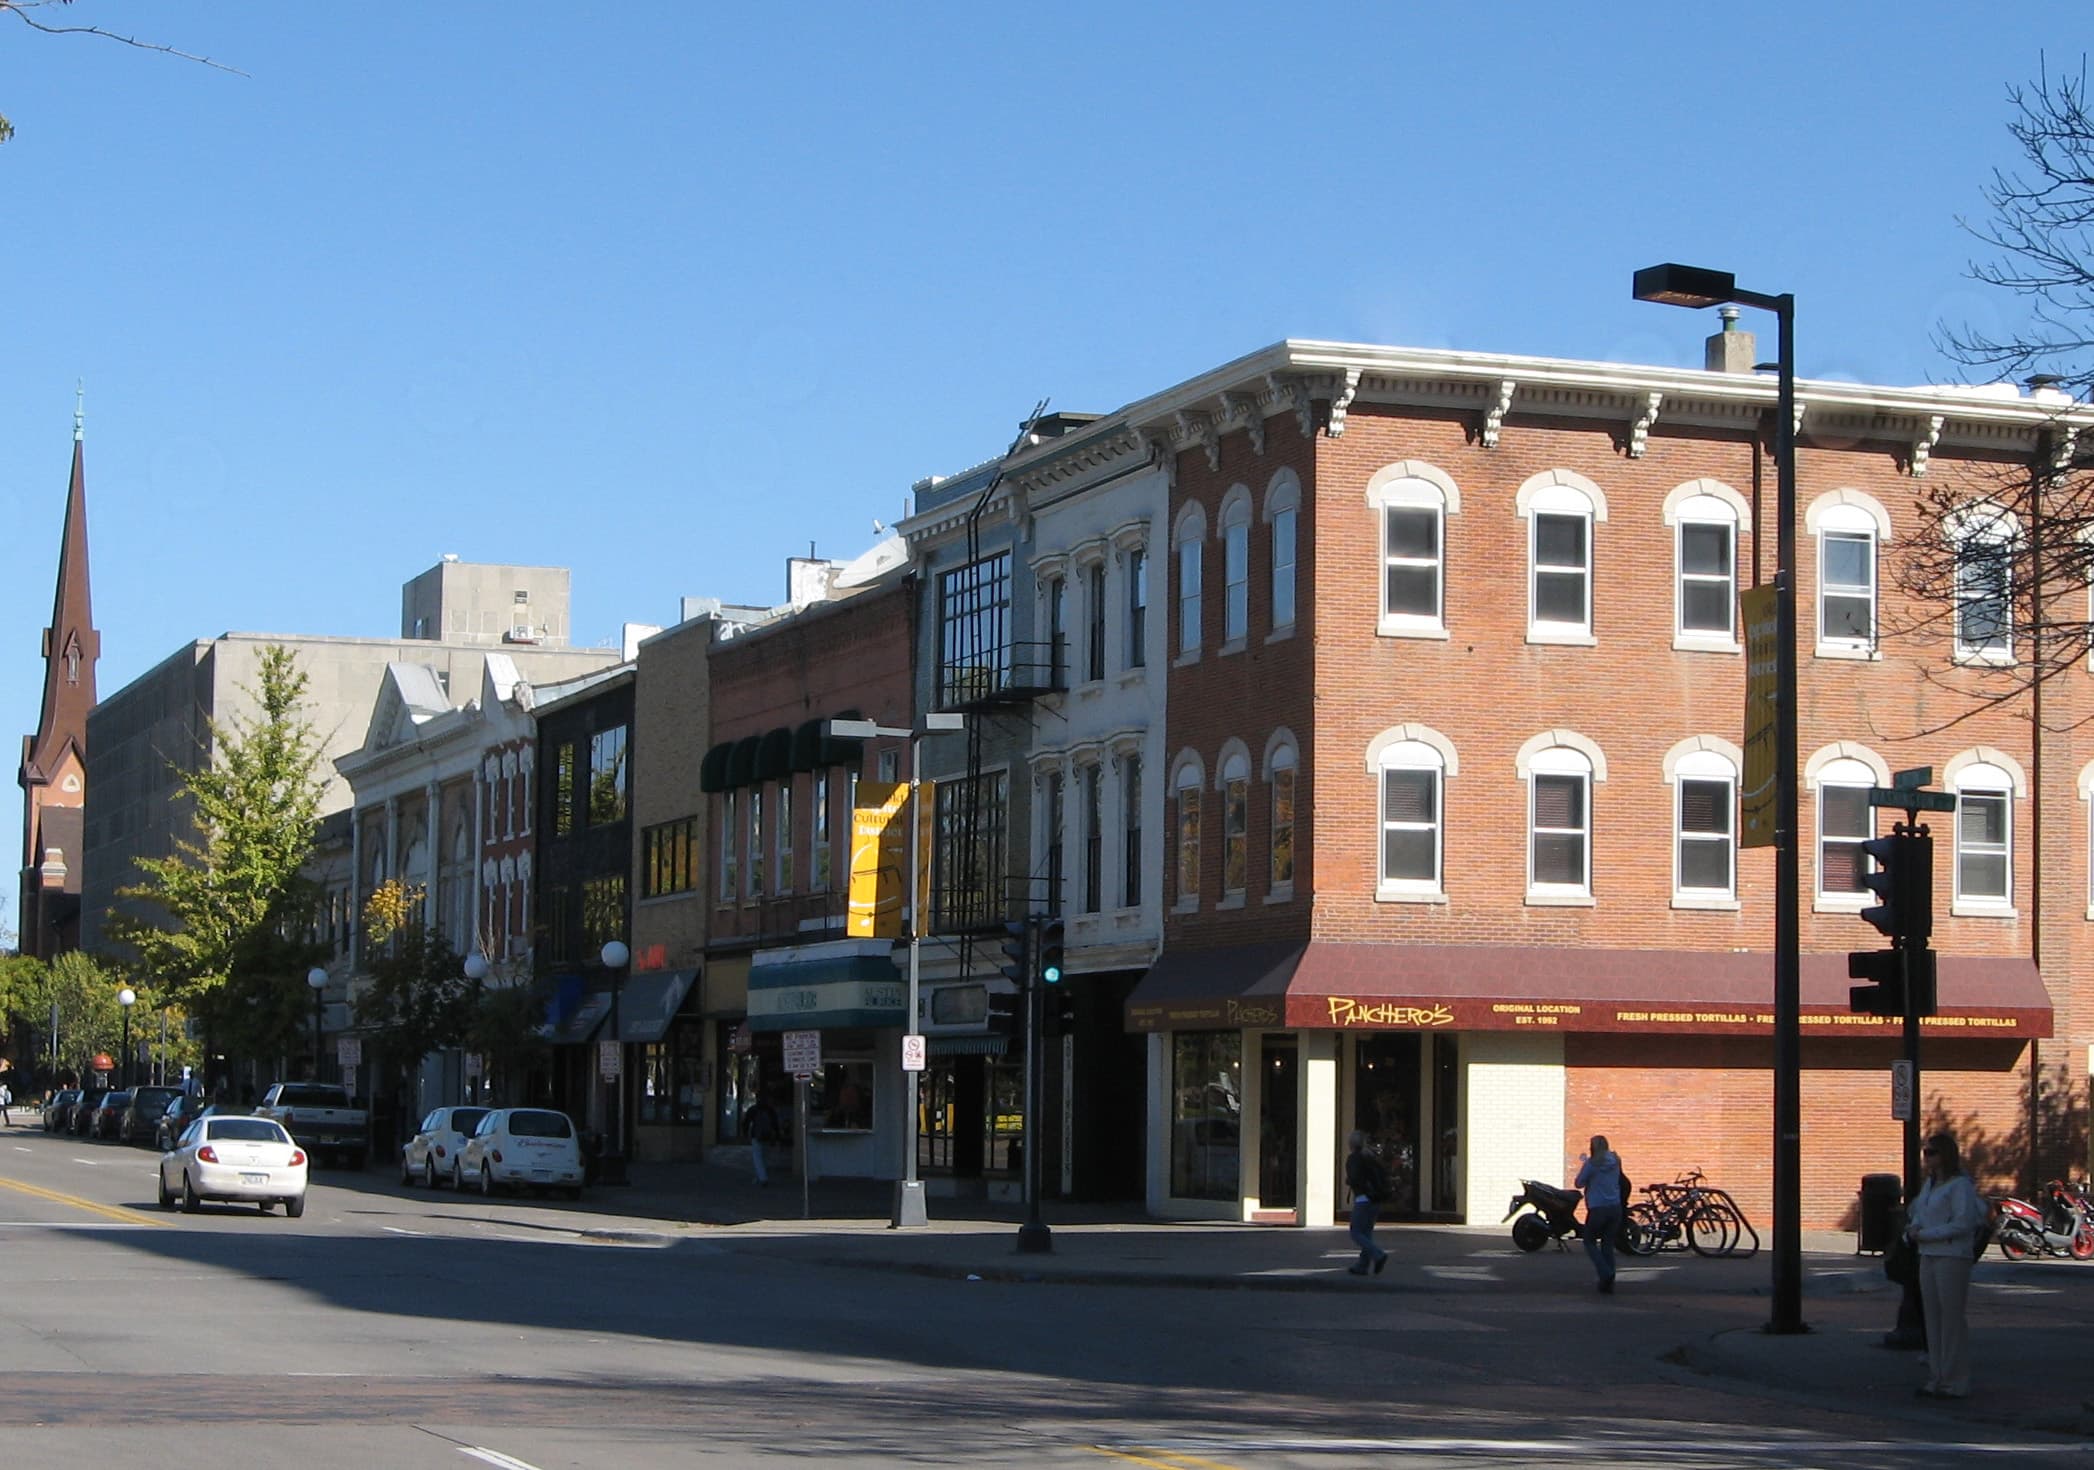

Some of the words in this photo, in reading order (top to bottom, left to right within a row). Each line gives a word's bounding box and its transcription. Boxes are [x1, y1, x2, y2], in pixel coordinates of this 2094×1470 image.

[1492, 1004, 1535, 1013] ORIGINAL
[1536, 1005, 1581, 1014] LOCATION
[1515, 1016, 1536, 1025] EST.
[1616, 1012, 1649, 1021] FRESH
[1650, 1013, 1694, 1022] PRESSED
[1695, 1014, 1747, 1023] TORTILLAS
[1756, 1014, 1776, 1024] FRE
[1833, 1015, 1884, 1025] TORTILLAS
[1925, 1017, 1966, 1026] PRESSED
[1967, 1018, 2017, 1027] TORTILLAS
